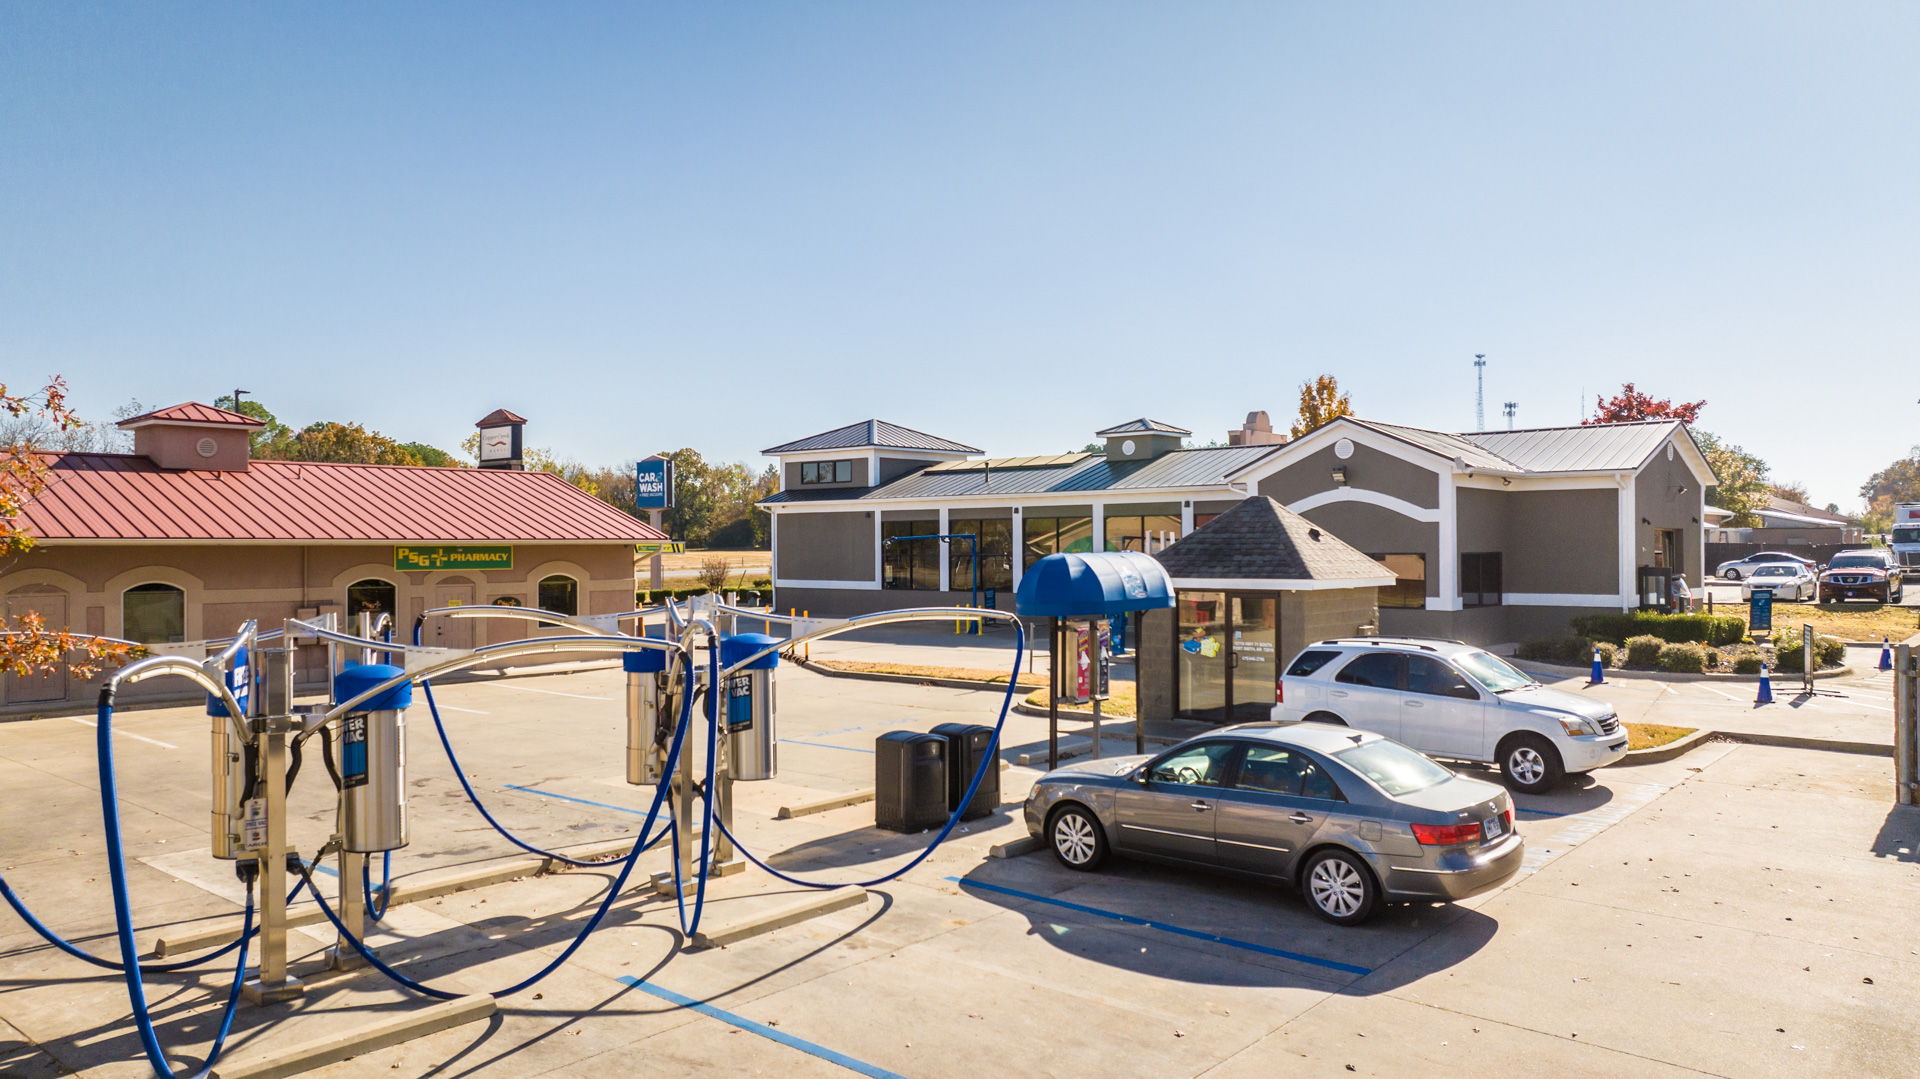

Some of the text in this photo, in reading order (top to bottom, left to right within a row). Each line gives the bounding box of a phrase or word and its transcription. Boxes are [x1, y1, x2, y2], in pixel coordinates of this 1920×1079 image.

[639, 472, 655, 482] CAR
[639, 482, 663, 492] WASH
[398, 548, 508, 567] PSG PHARMACY
